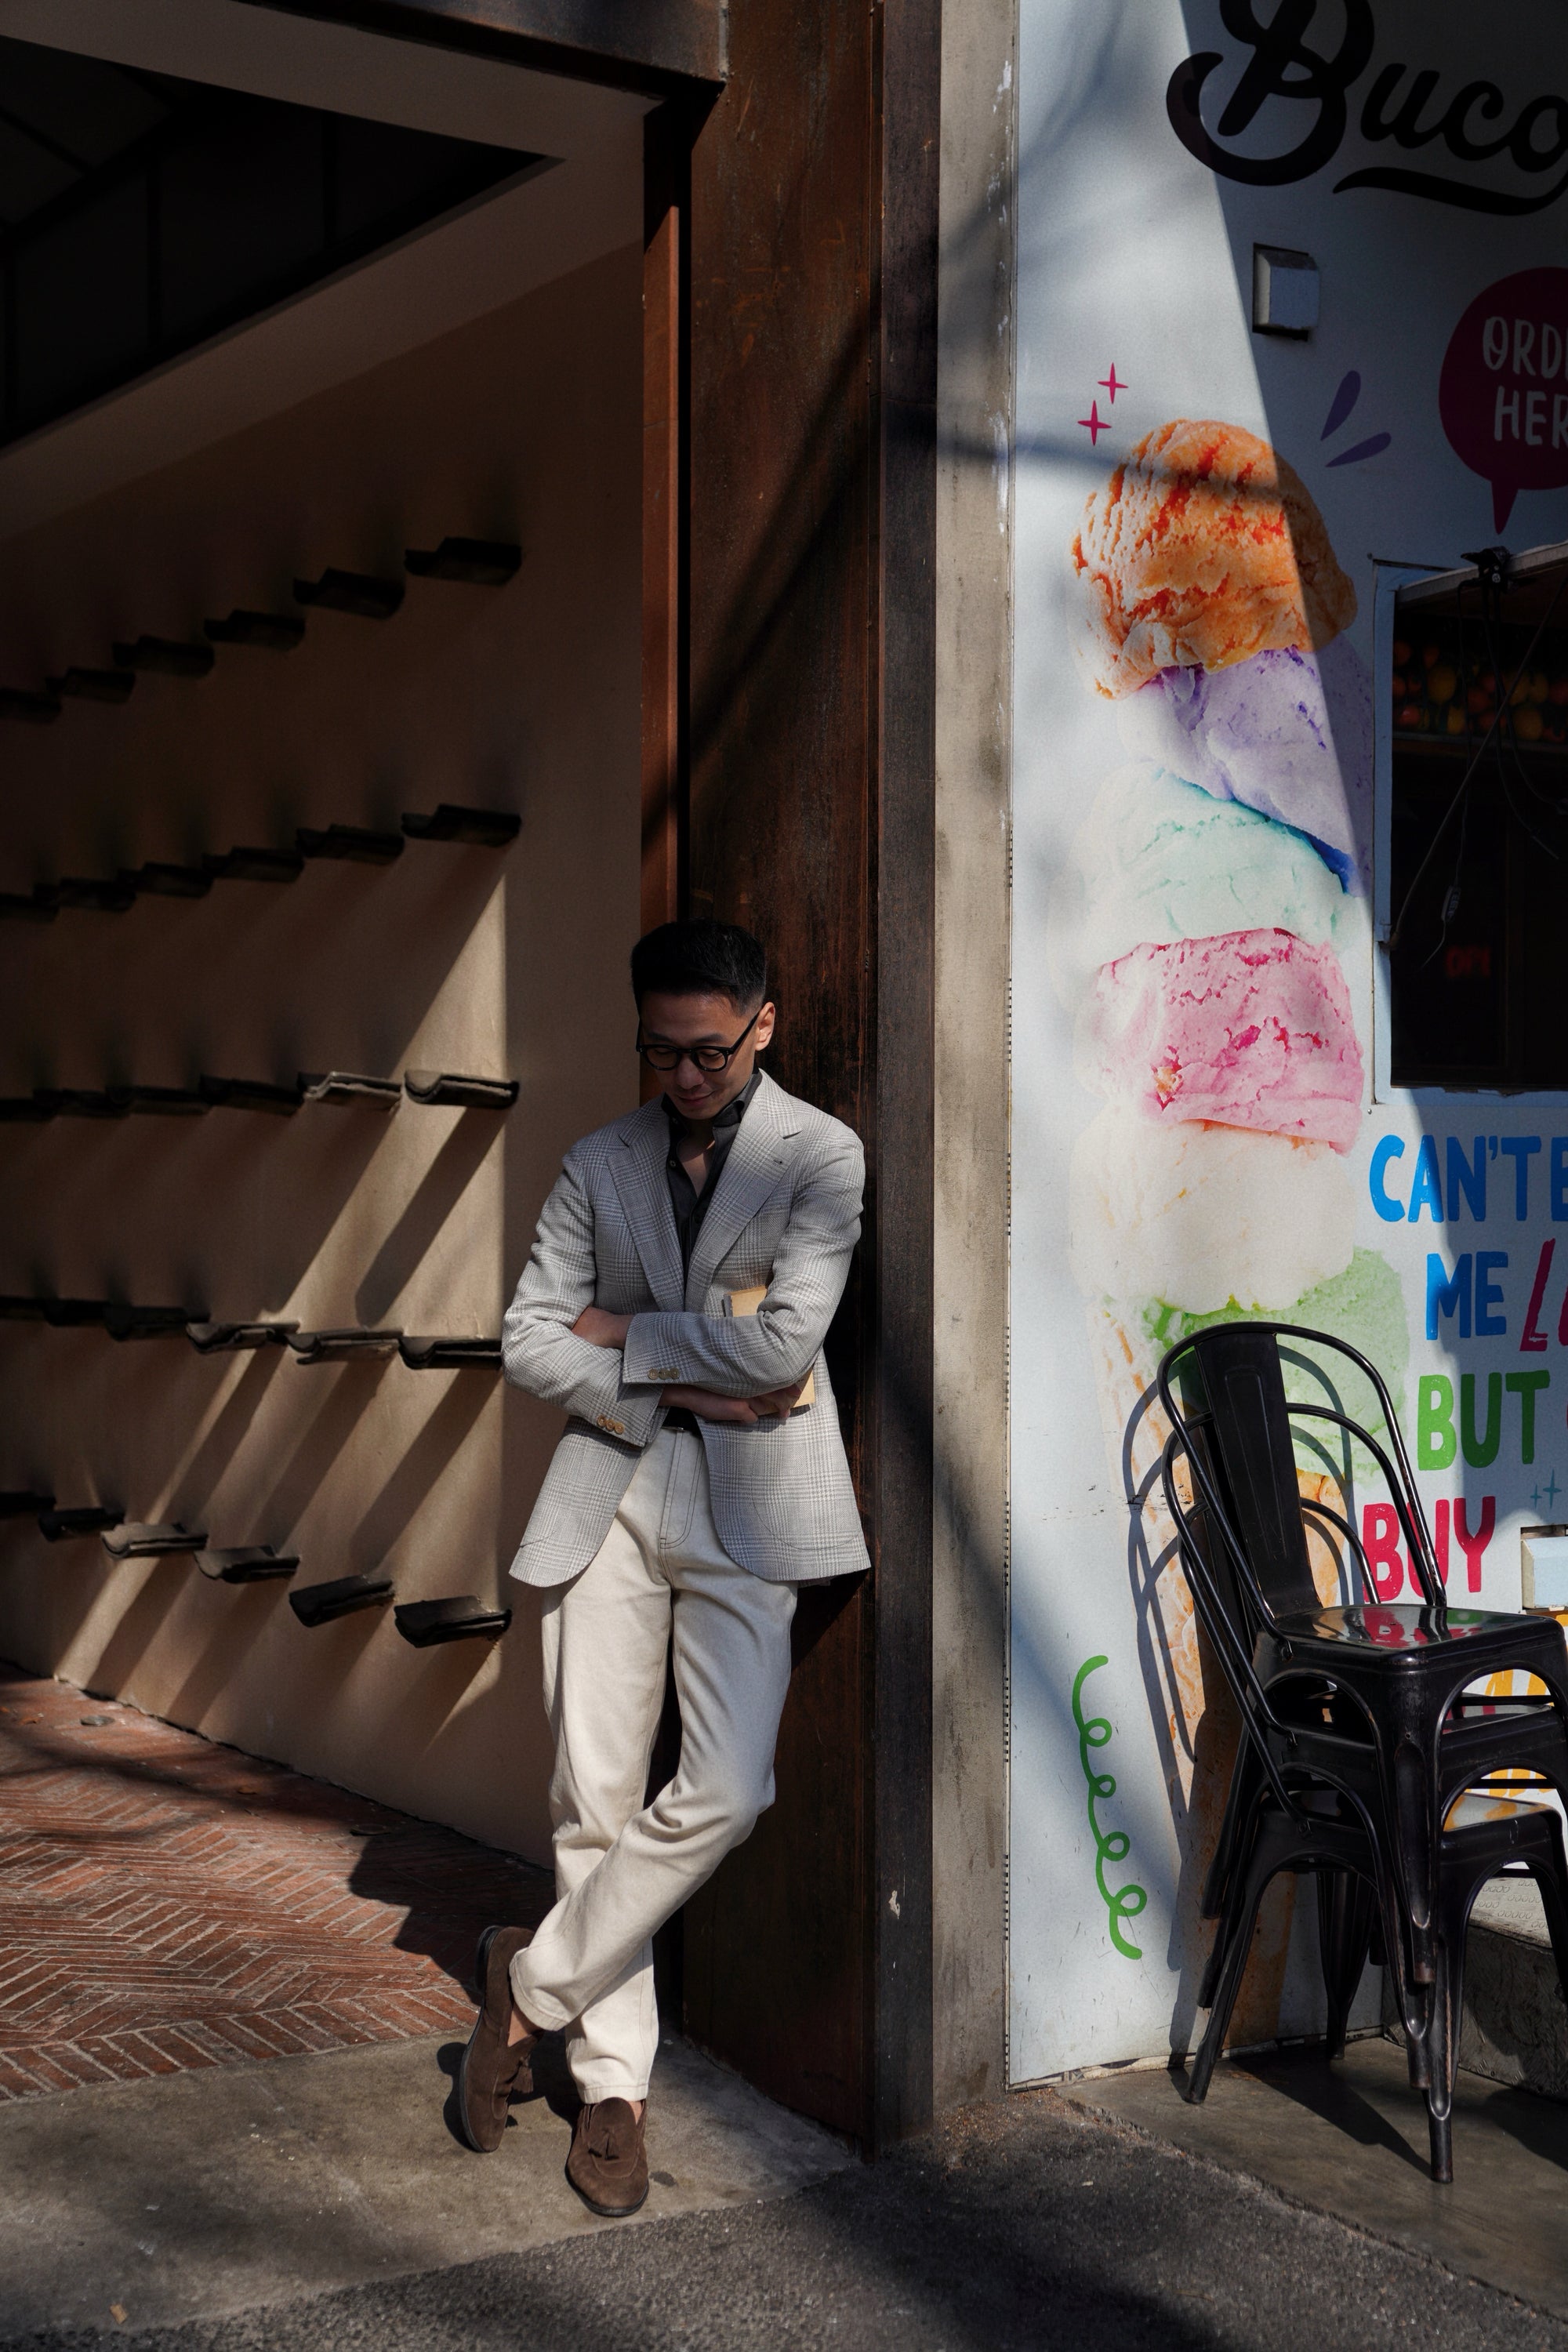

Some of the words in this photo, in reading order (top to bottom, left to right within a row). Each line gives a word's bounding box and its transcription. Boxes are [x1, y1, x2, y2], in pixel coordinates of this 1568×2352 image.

[1483, 316, 1568, 381] ORD
[1370, 1134, 1541, 1222] CAN'T
[1426, 1252, 1508, 1340] ME
[1417, 1370, 1551, 1471] BUT
[1363, 1496, 1496, 1602] BUY
